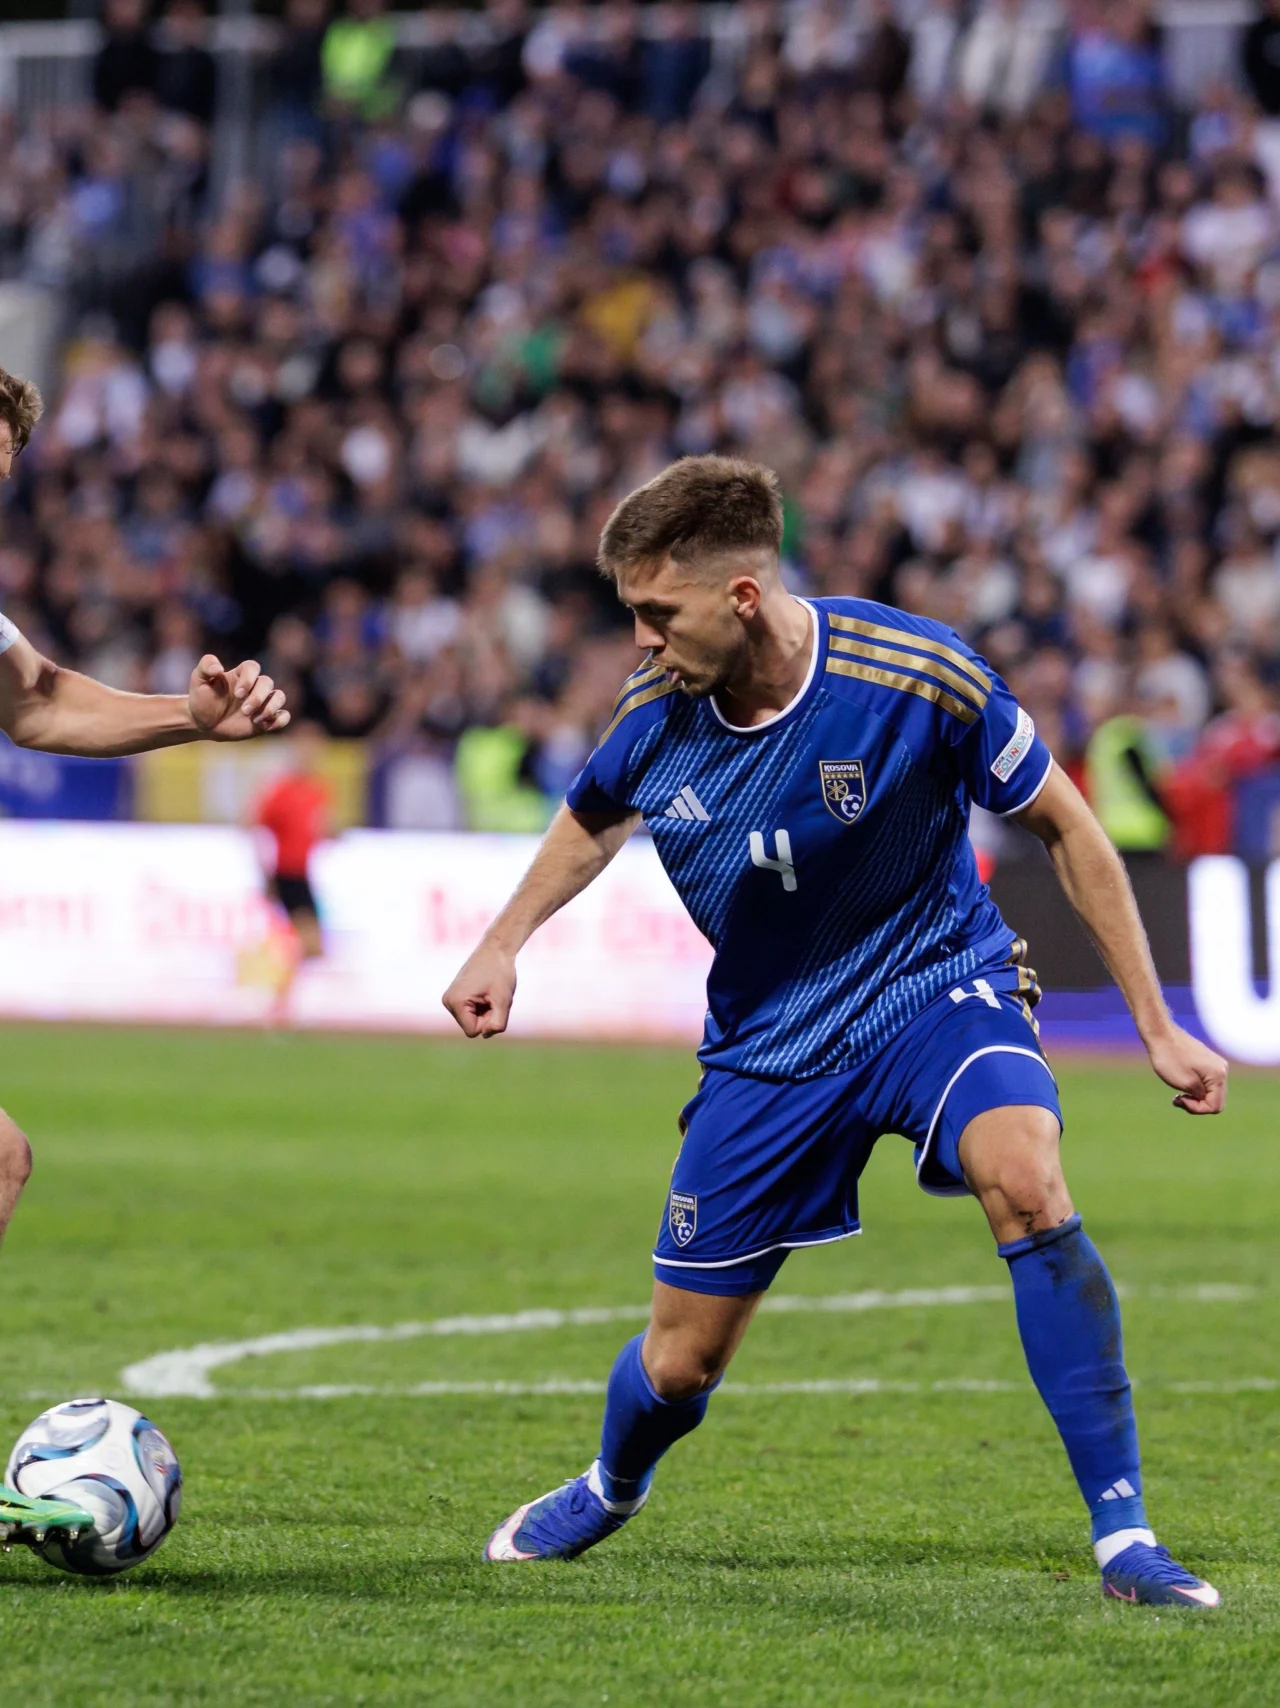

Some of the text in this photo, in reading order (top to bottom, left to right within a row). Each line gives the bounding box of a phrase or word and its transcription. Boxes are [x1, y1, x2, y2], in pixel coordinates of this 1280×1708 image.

[823, 764, 859, 773] KOSOVA
[749, 828, 798, 892] 4
[948, 978, 1002, 1010] 4
